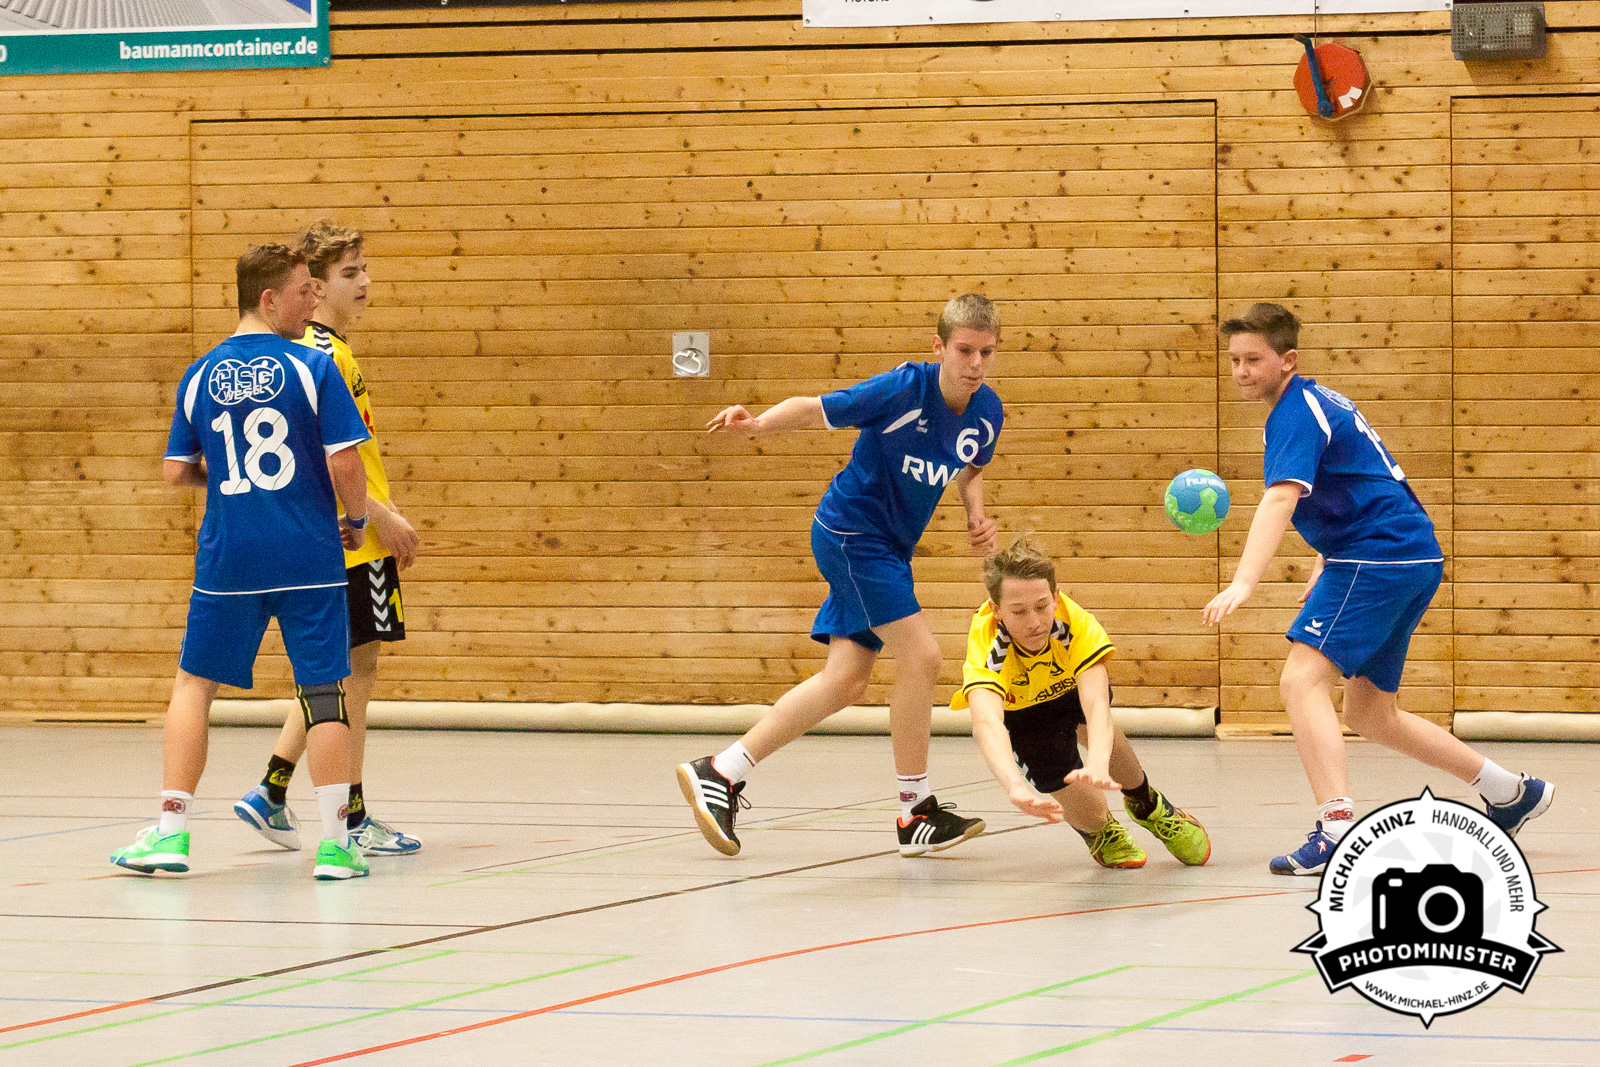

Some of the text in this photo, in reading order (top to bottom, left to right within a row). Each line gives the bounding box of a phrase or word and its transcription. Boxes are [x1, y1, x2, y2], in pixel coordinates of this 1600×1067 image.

[119, 36, 318, 60] baumanncontainer.de
[211, 407, 296, 496] 18
[956, 427, 980, 463] 6
[388, 588, 405, 623] 1
